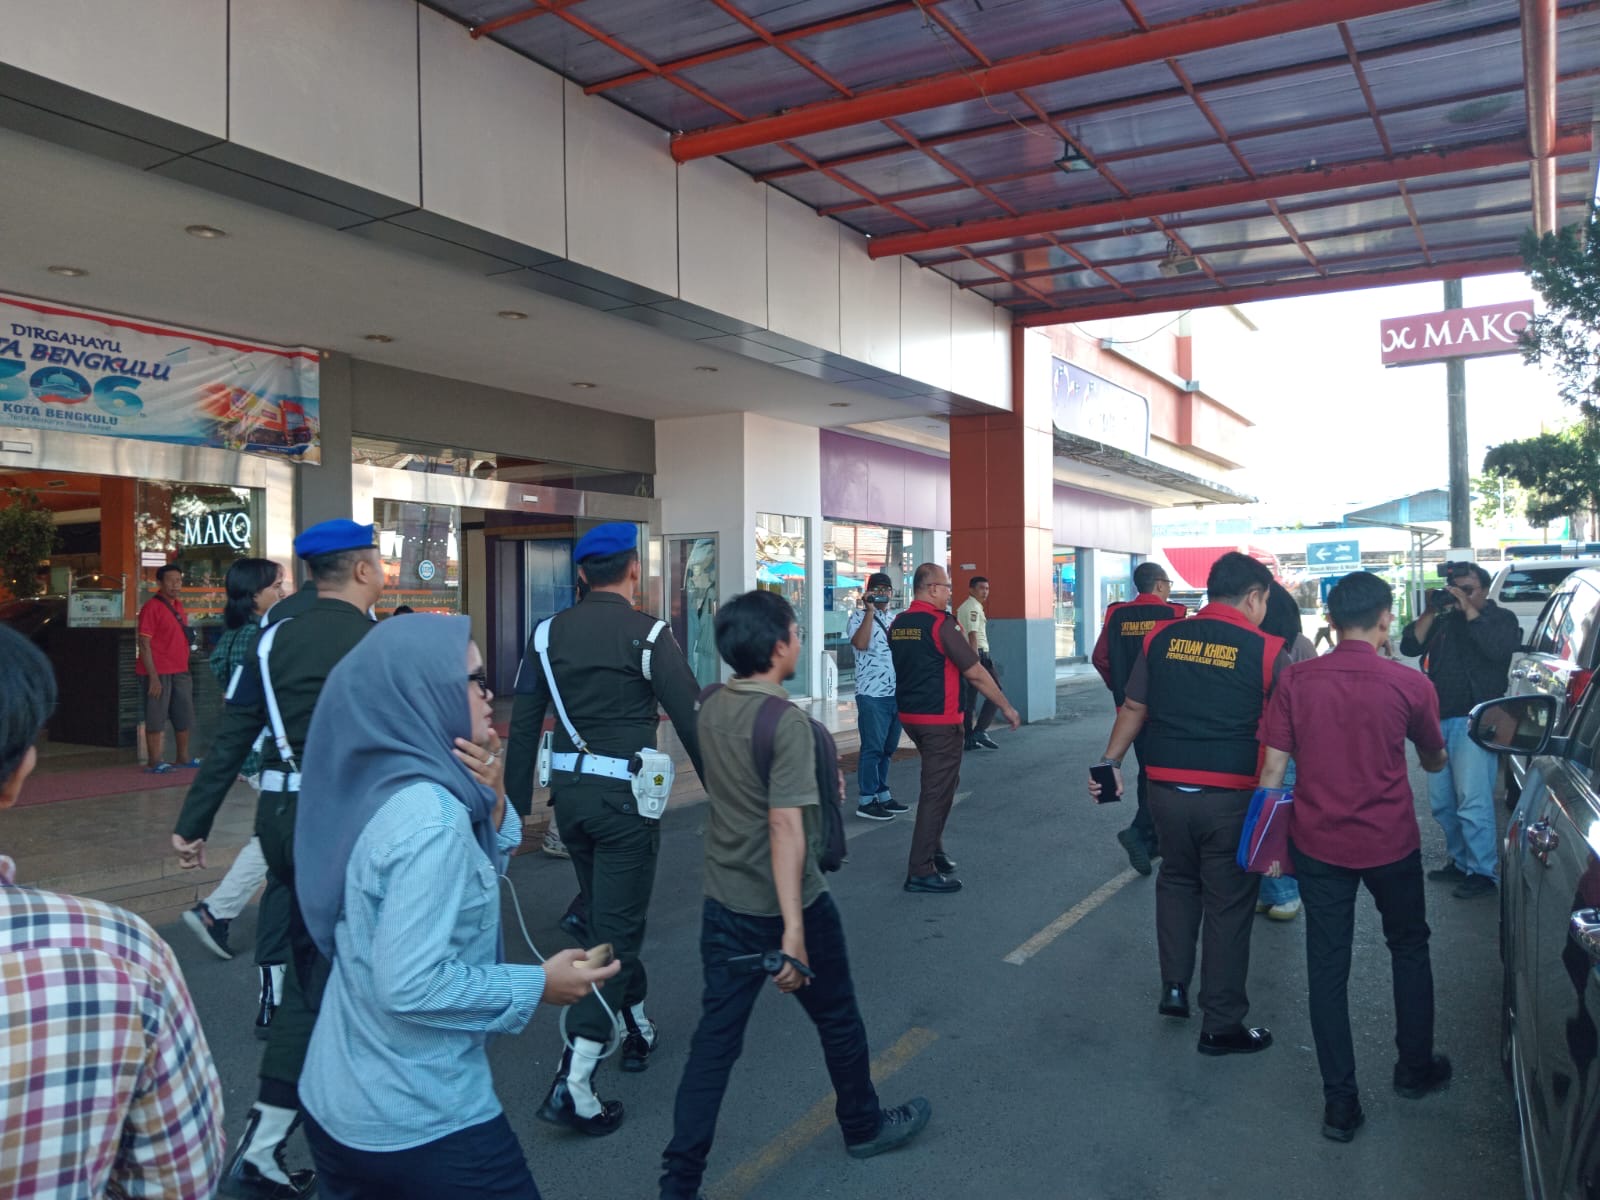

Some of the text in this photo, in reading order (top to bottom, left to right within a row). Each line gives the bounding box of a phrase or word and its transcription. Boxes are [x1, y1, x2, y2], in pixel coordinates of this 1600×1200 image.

[11, 323, 122, 353] DIRGAHAYU
[1422, 311, 1532, 348] MAKO
[31, 343, 171, 381] BENGKULU
[3, 403, 41, 417] KOTA
[46, 408, 118, 425] BENGKULU
[1168, 638, 1239, 661] SATUAN KHUSUS
